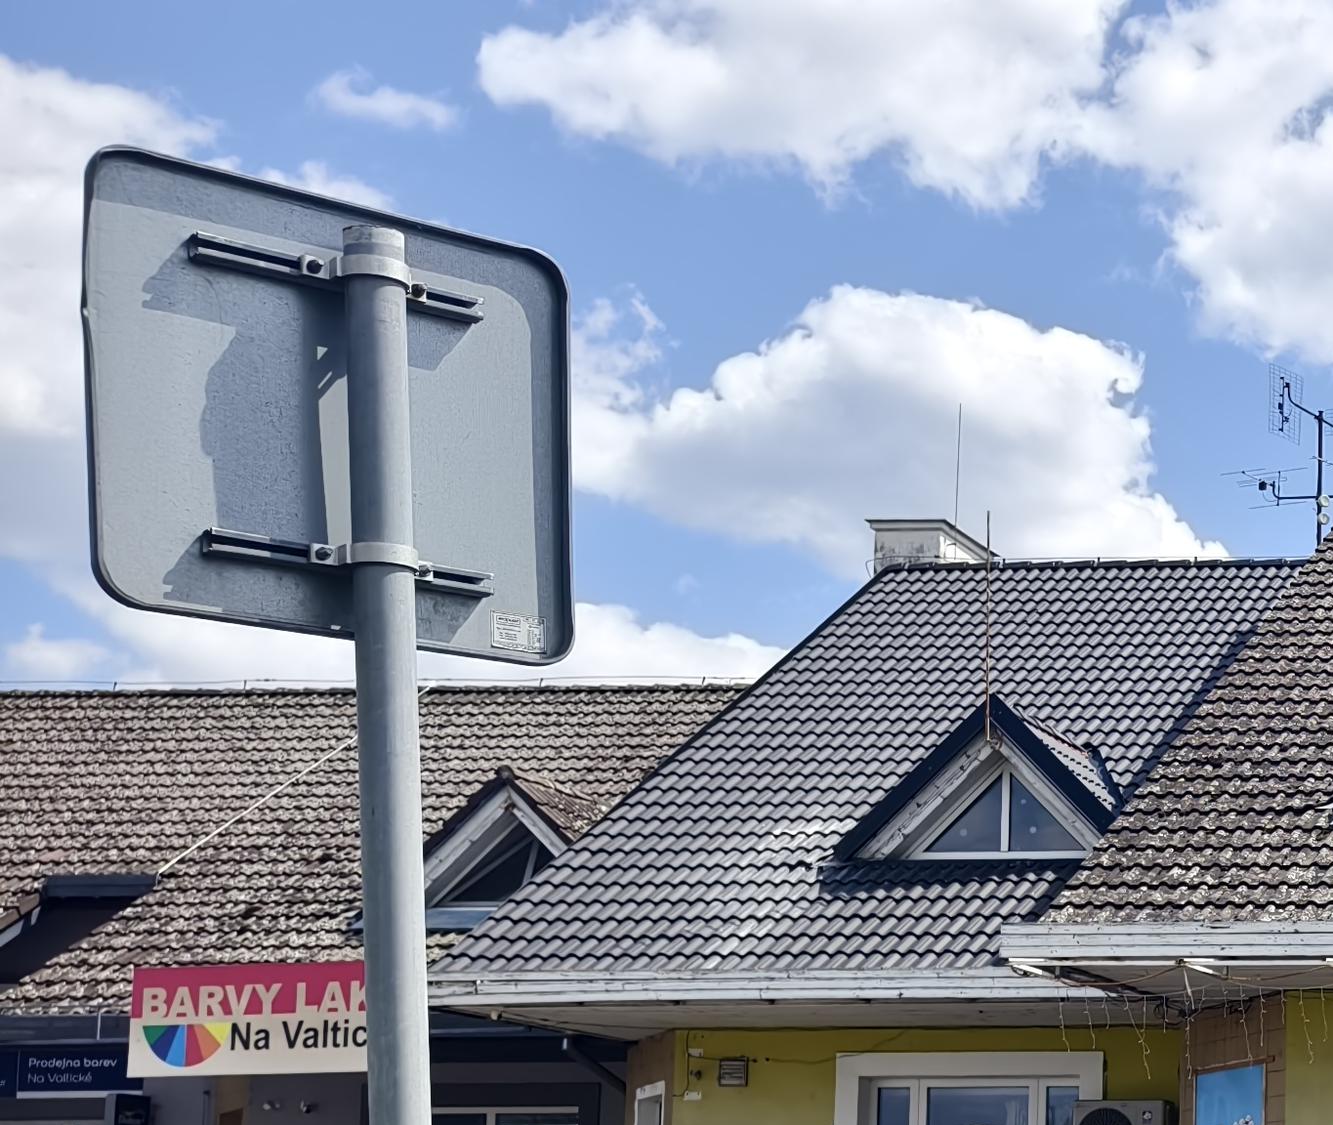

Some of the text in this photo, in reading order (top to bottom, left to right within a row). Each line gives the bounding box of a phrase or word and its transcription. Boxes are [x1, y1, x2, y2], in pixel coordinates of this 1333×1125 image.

[142, 983, 281, 1019] BARVY
[230, 1022, 270, 1050] Na
[28, 1057, 117, 1070] Prodejna barev
[27, 1073, 45, 1083] Na
